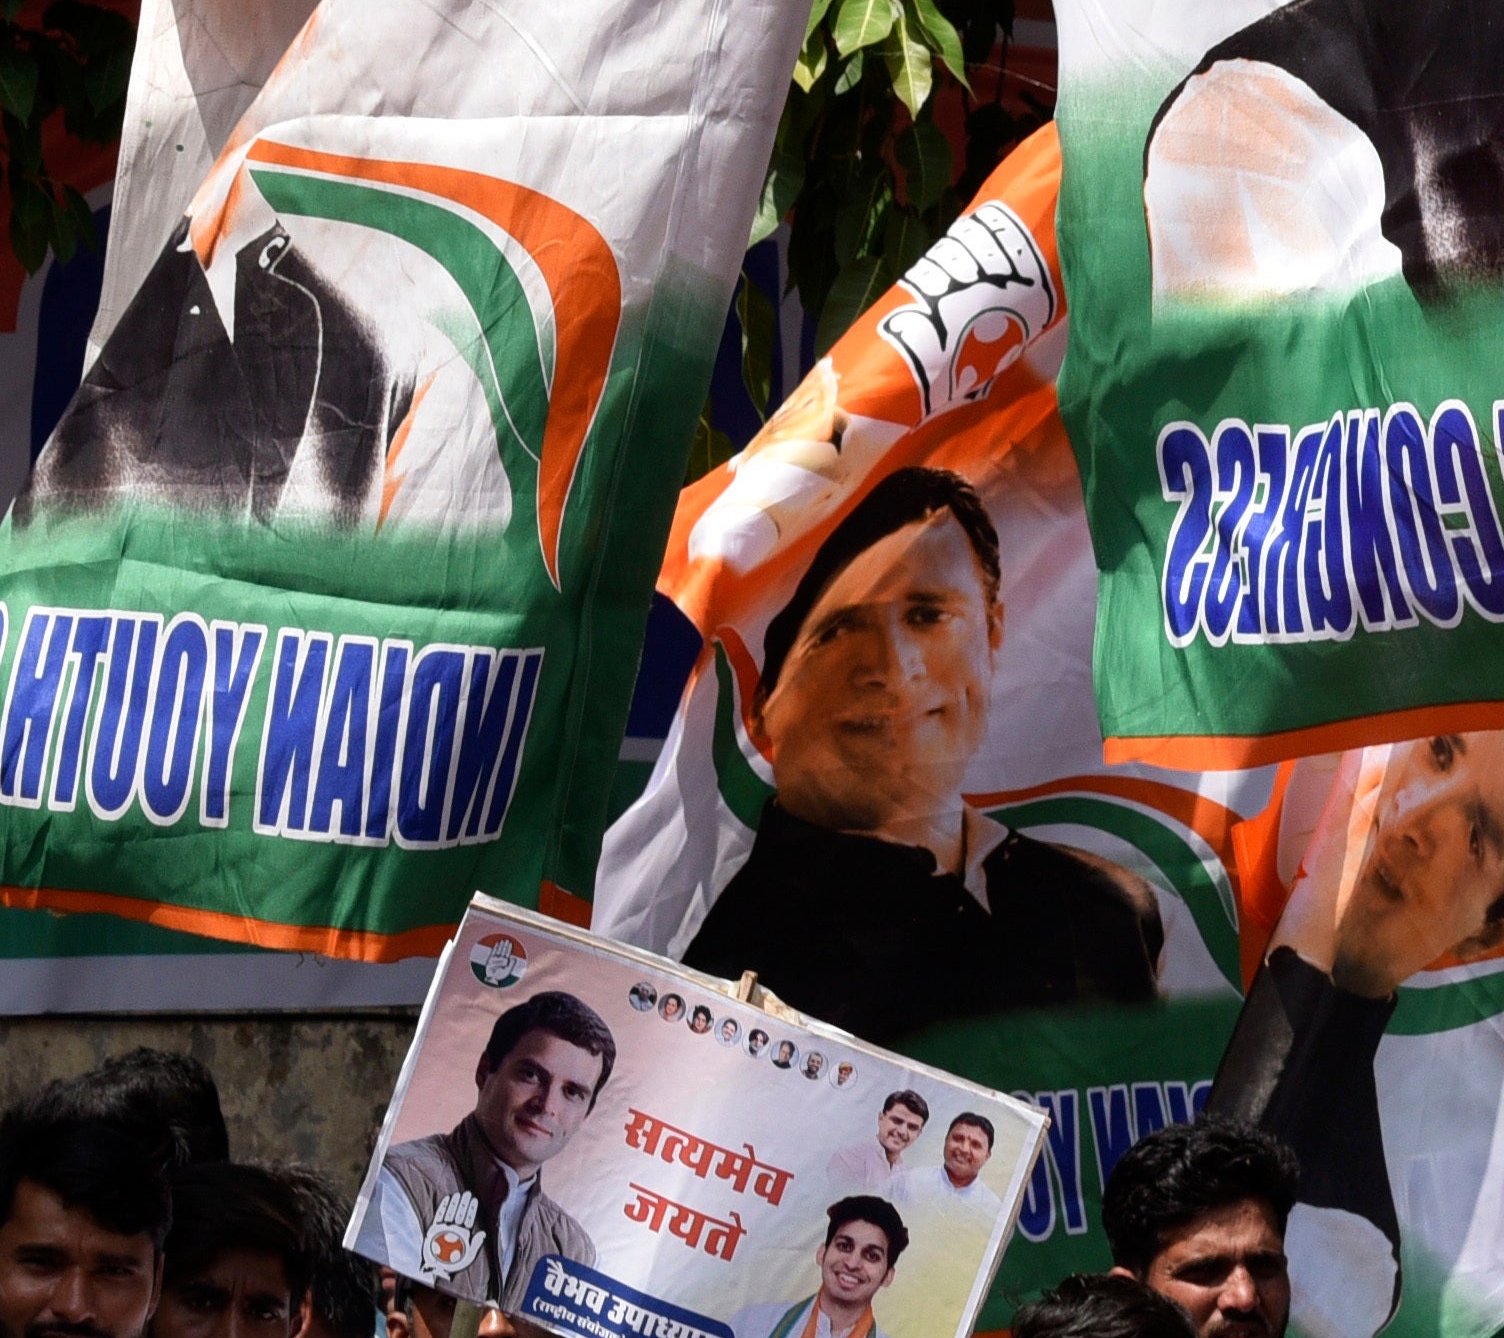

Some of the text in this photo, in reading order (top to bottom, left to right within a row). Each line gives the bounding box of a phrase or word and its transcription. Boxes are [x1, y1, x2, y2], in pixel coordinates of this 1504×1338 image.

[623, 1107, 794, 1206] सत्यमेव
[623, 1182, 747, 1262] जयते
[544, 1257, 610, 1316] वैभव
